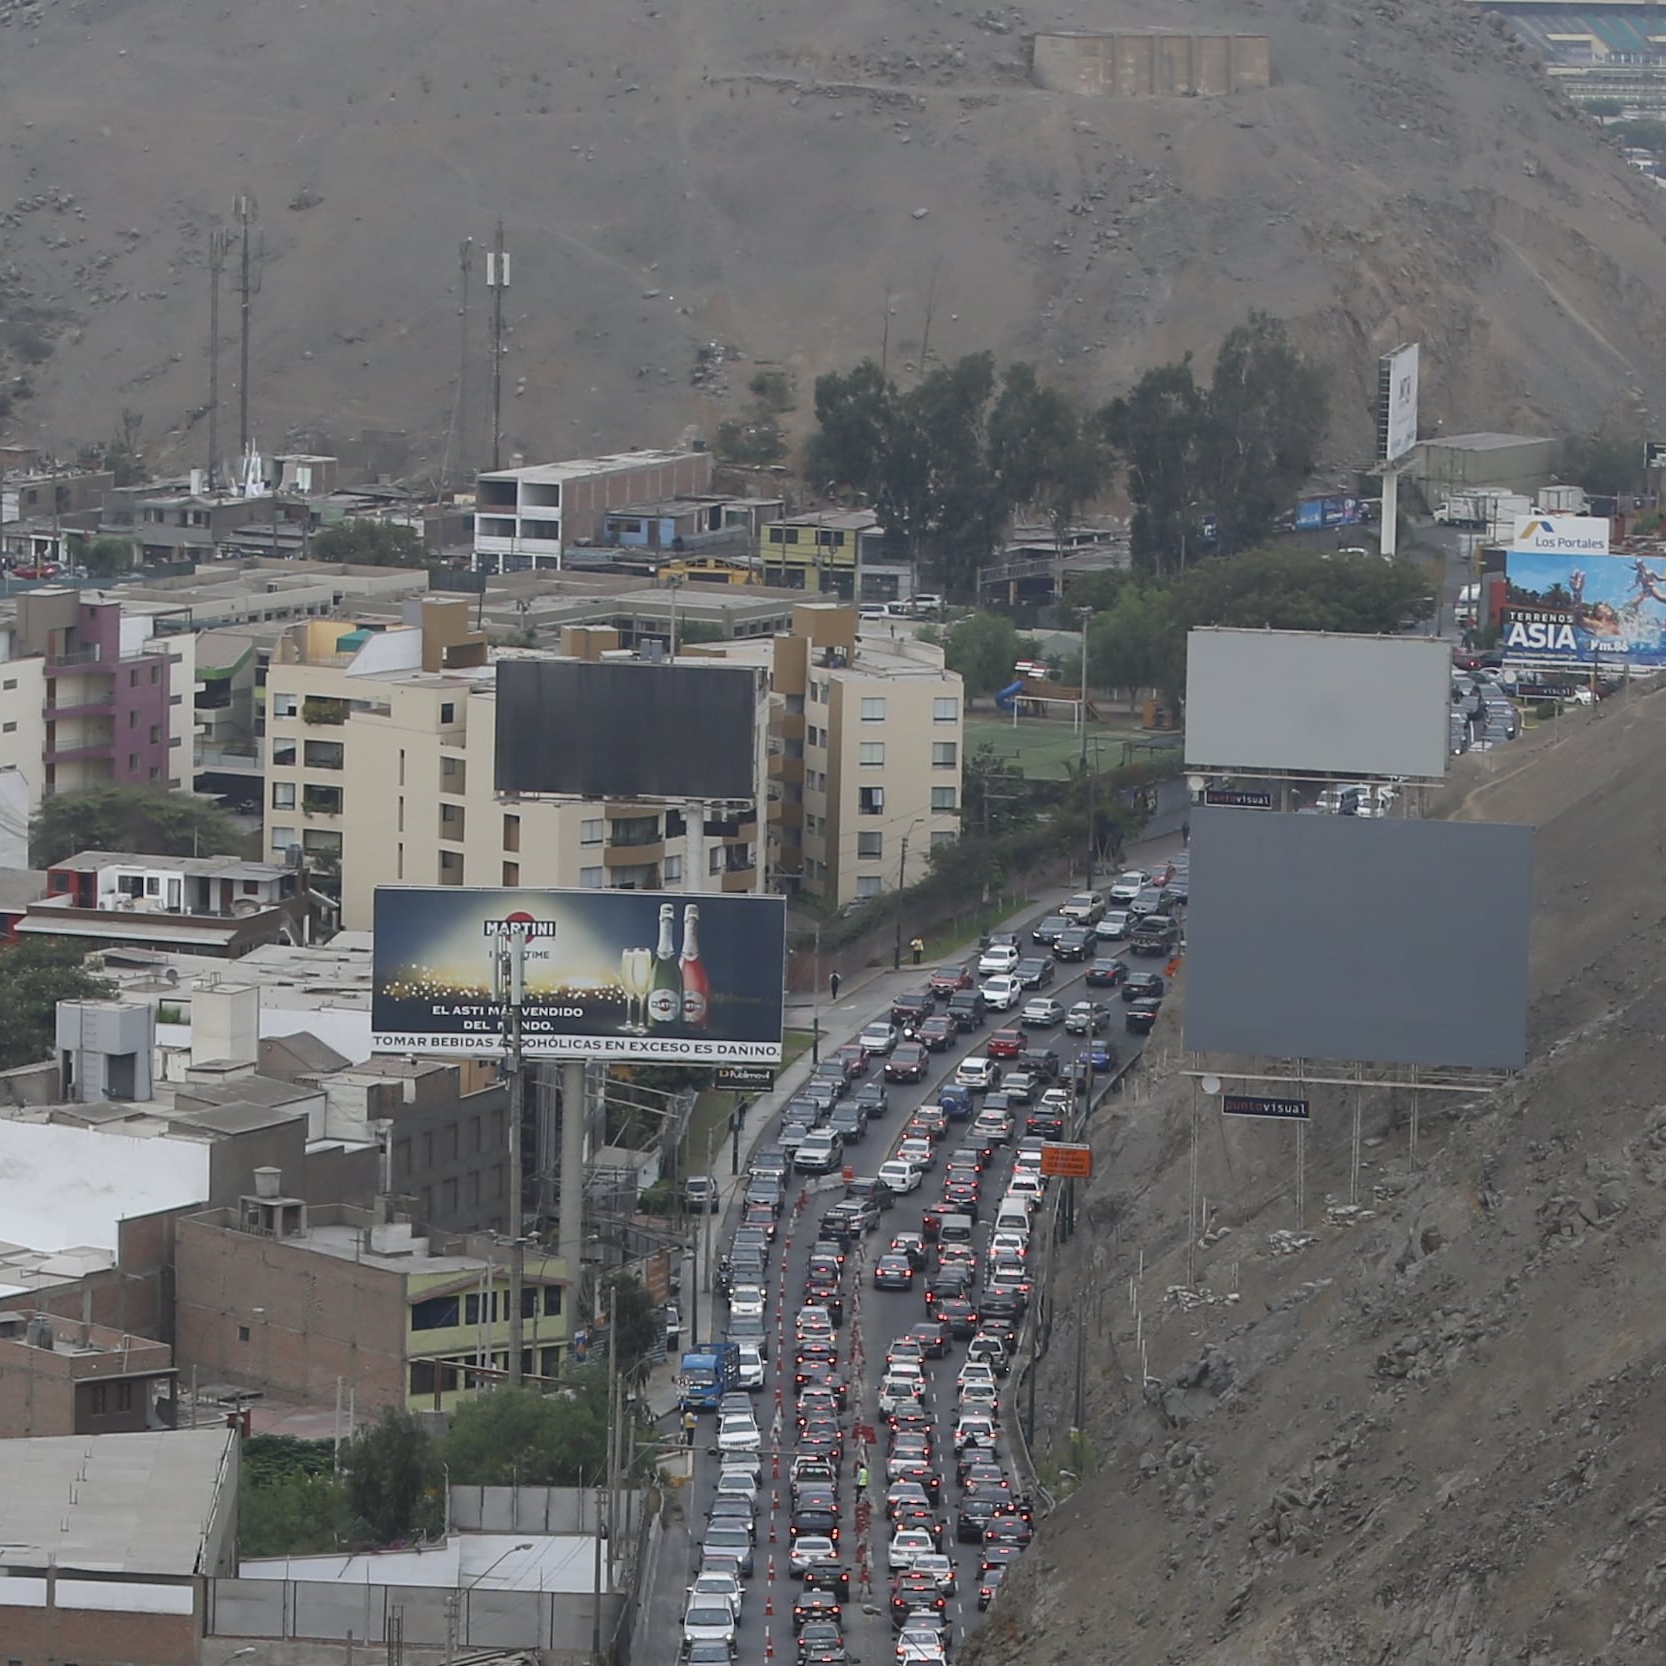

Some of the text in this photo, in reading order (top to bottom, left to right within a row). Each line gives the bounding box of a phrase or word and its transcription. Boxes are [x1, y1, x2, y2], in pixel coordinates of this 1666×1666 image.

[1535, 537, 1605, 549] Los Portales
[1510, 611, 1574, 623] TERRENOS
[1507, 622, 1577, 650] ASIA
[485, 921, 555, 936] MARTINI
[432, 1005, 450, 1015] EL
[452, 1005, 484, 1016] ASTI
[521, 1007, 583, 1018] VENDIDO
[463, 1020, 554, 1031] DEL MNDO.
[373, 1035, 427, 1047] TOMAR
[431, 1036, 494, 1048] BEBIDAS
[605, 1041, 625, 1050] EN
[629, 1041, 690, 1054] EXCESO
[694, 1044, 713, 1055] ES
[717, 1043, 780, 1057] DAÑINO.
[1225, 1100, 1306, 1114] puntovisual
